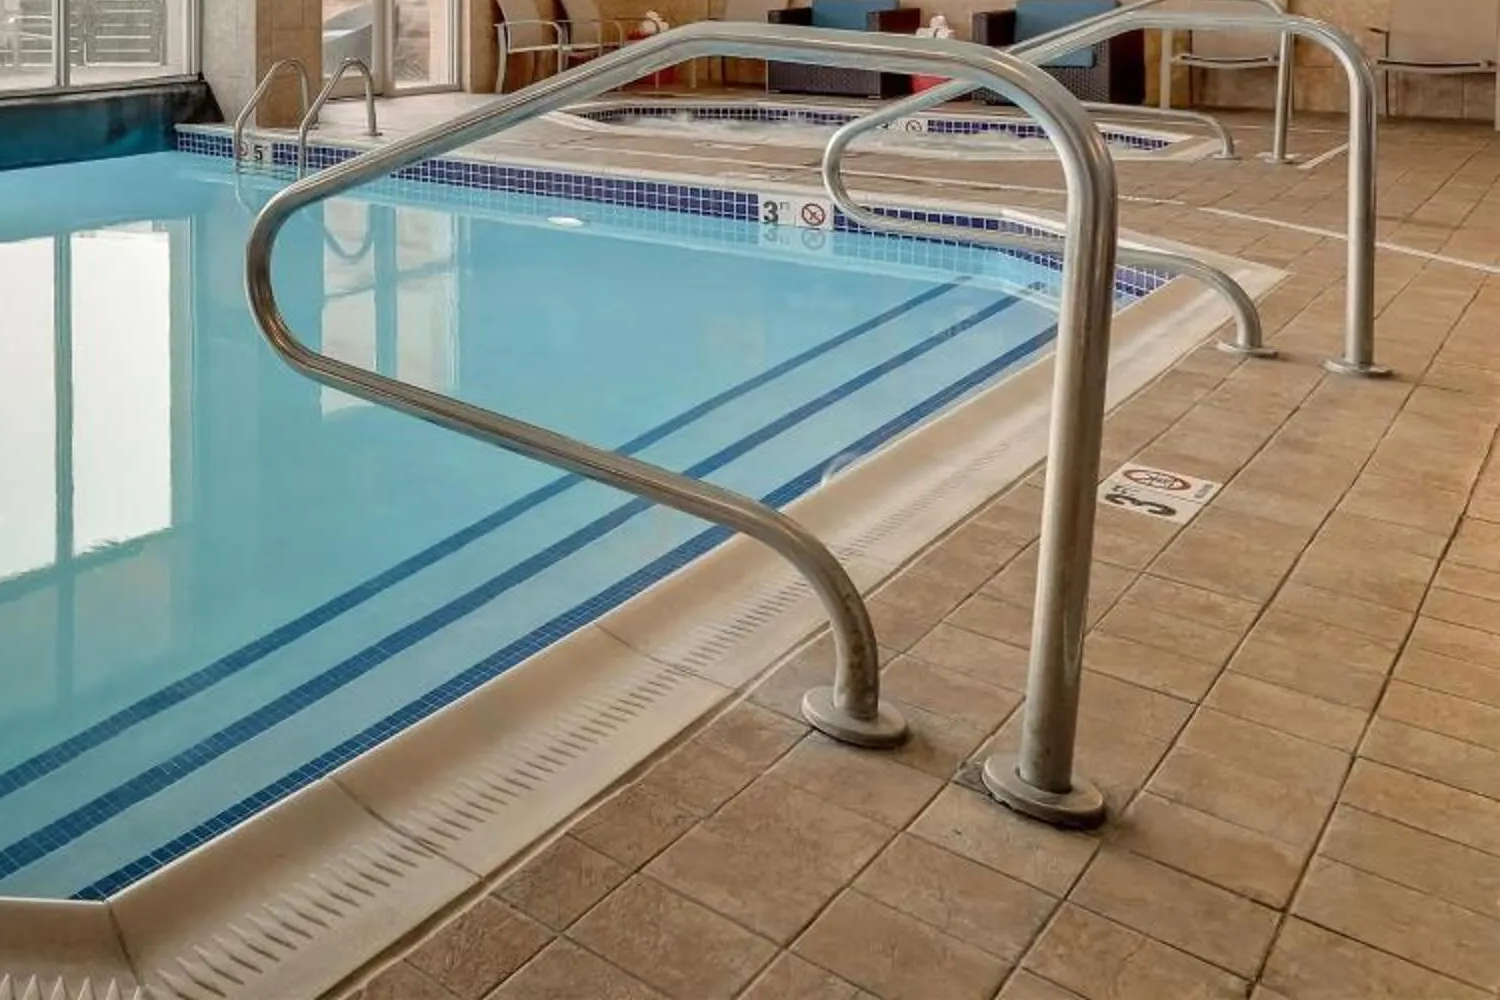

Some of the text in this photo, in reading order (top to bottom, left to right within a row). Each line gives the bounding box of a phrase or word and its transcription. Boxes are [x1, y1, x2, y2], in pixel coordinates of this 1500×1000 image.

[253, 144, 263, 161] 5
[763, 200, 778, 224] 3
[1105, 493, 1177, 516] 3
